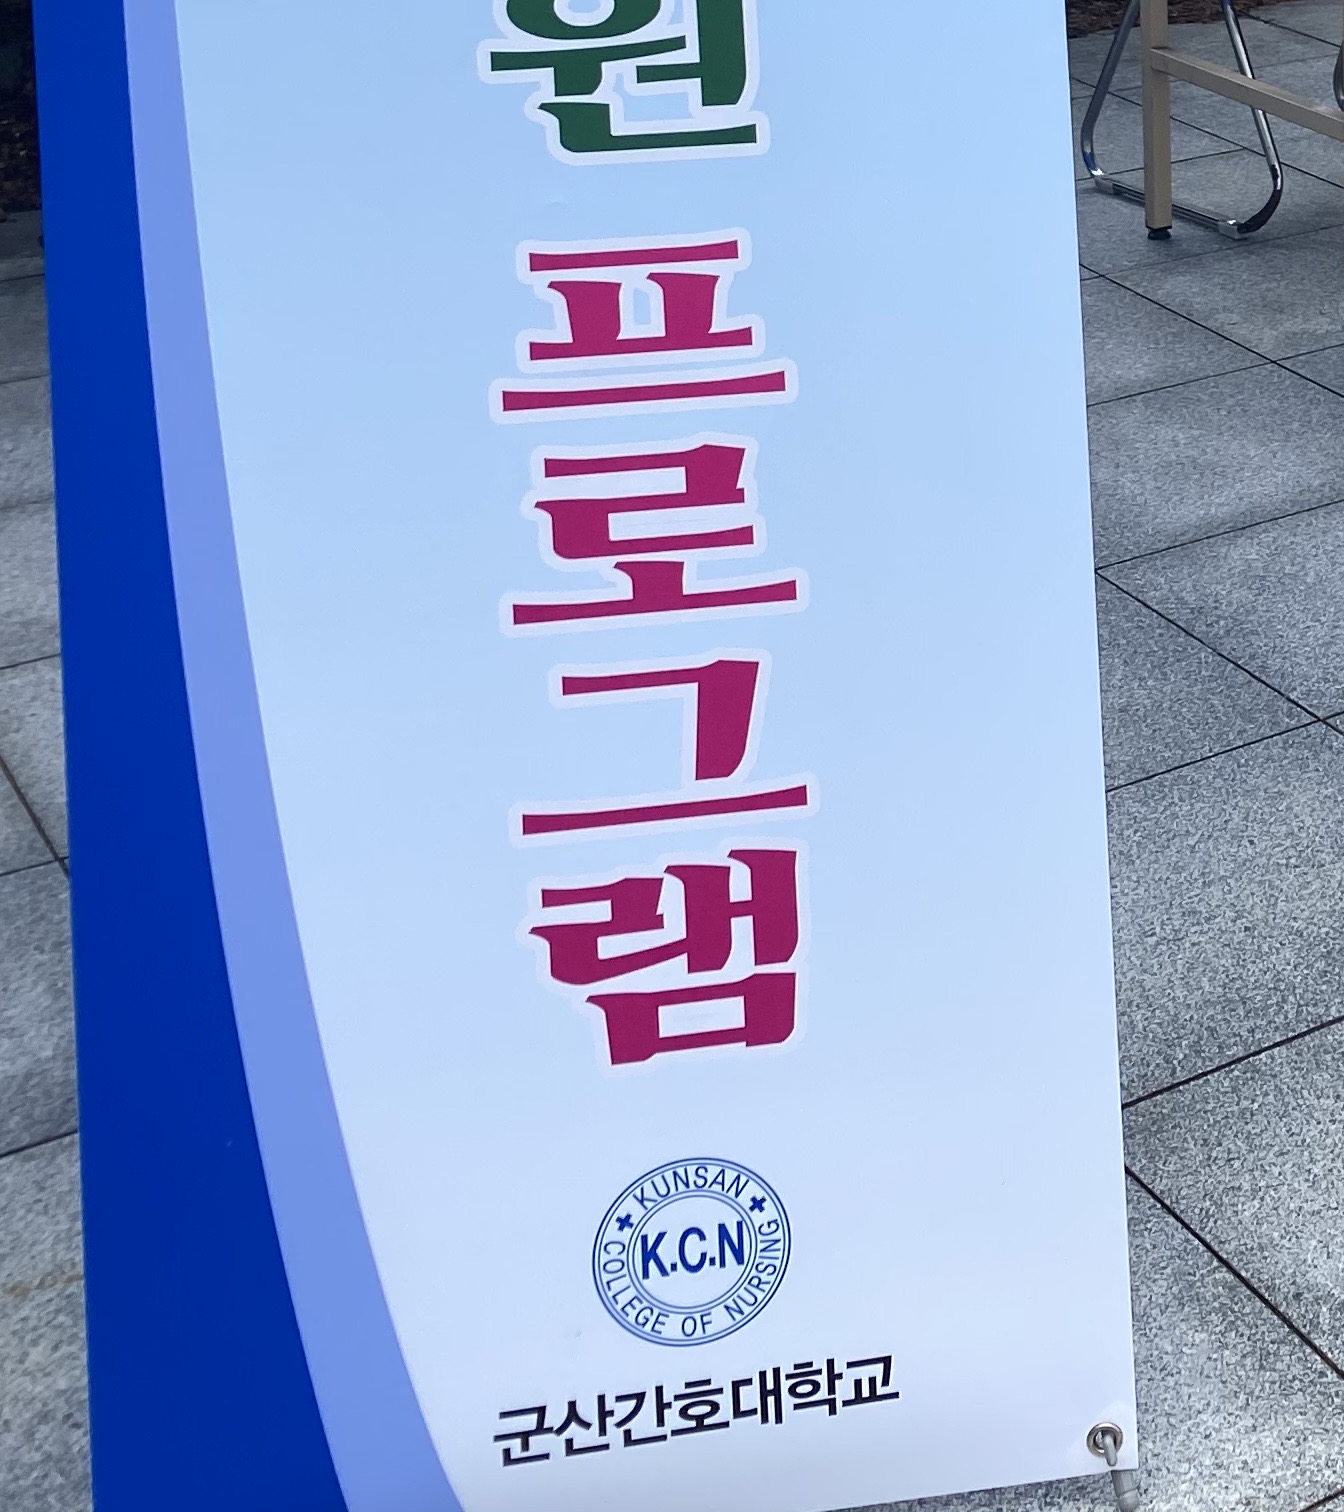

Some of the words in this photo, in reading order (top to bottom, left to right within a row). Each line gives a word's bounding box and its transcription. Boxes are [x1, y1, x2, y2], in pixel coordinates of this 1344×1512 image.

[499, 239, 808, 1065] 프로그램
[632, 1165, 750, 1211] KUNSAN
[602, 1240, 670, 1335] COLLEGE
[681, 1311, 713, 1337] OF
[723, 1218, 782, 1322] NURSING
[640, 1220, 745, 1280] K.C.N
[494, 1355, 901, 1466] 군산간호대학교
